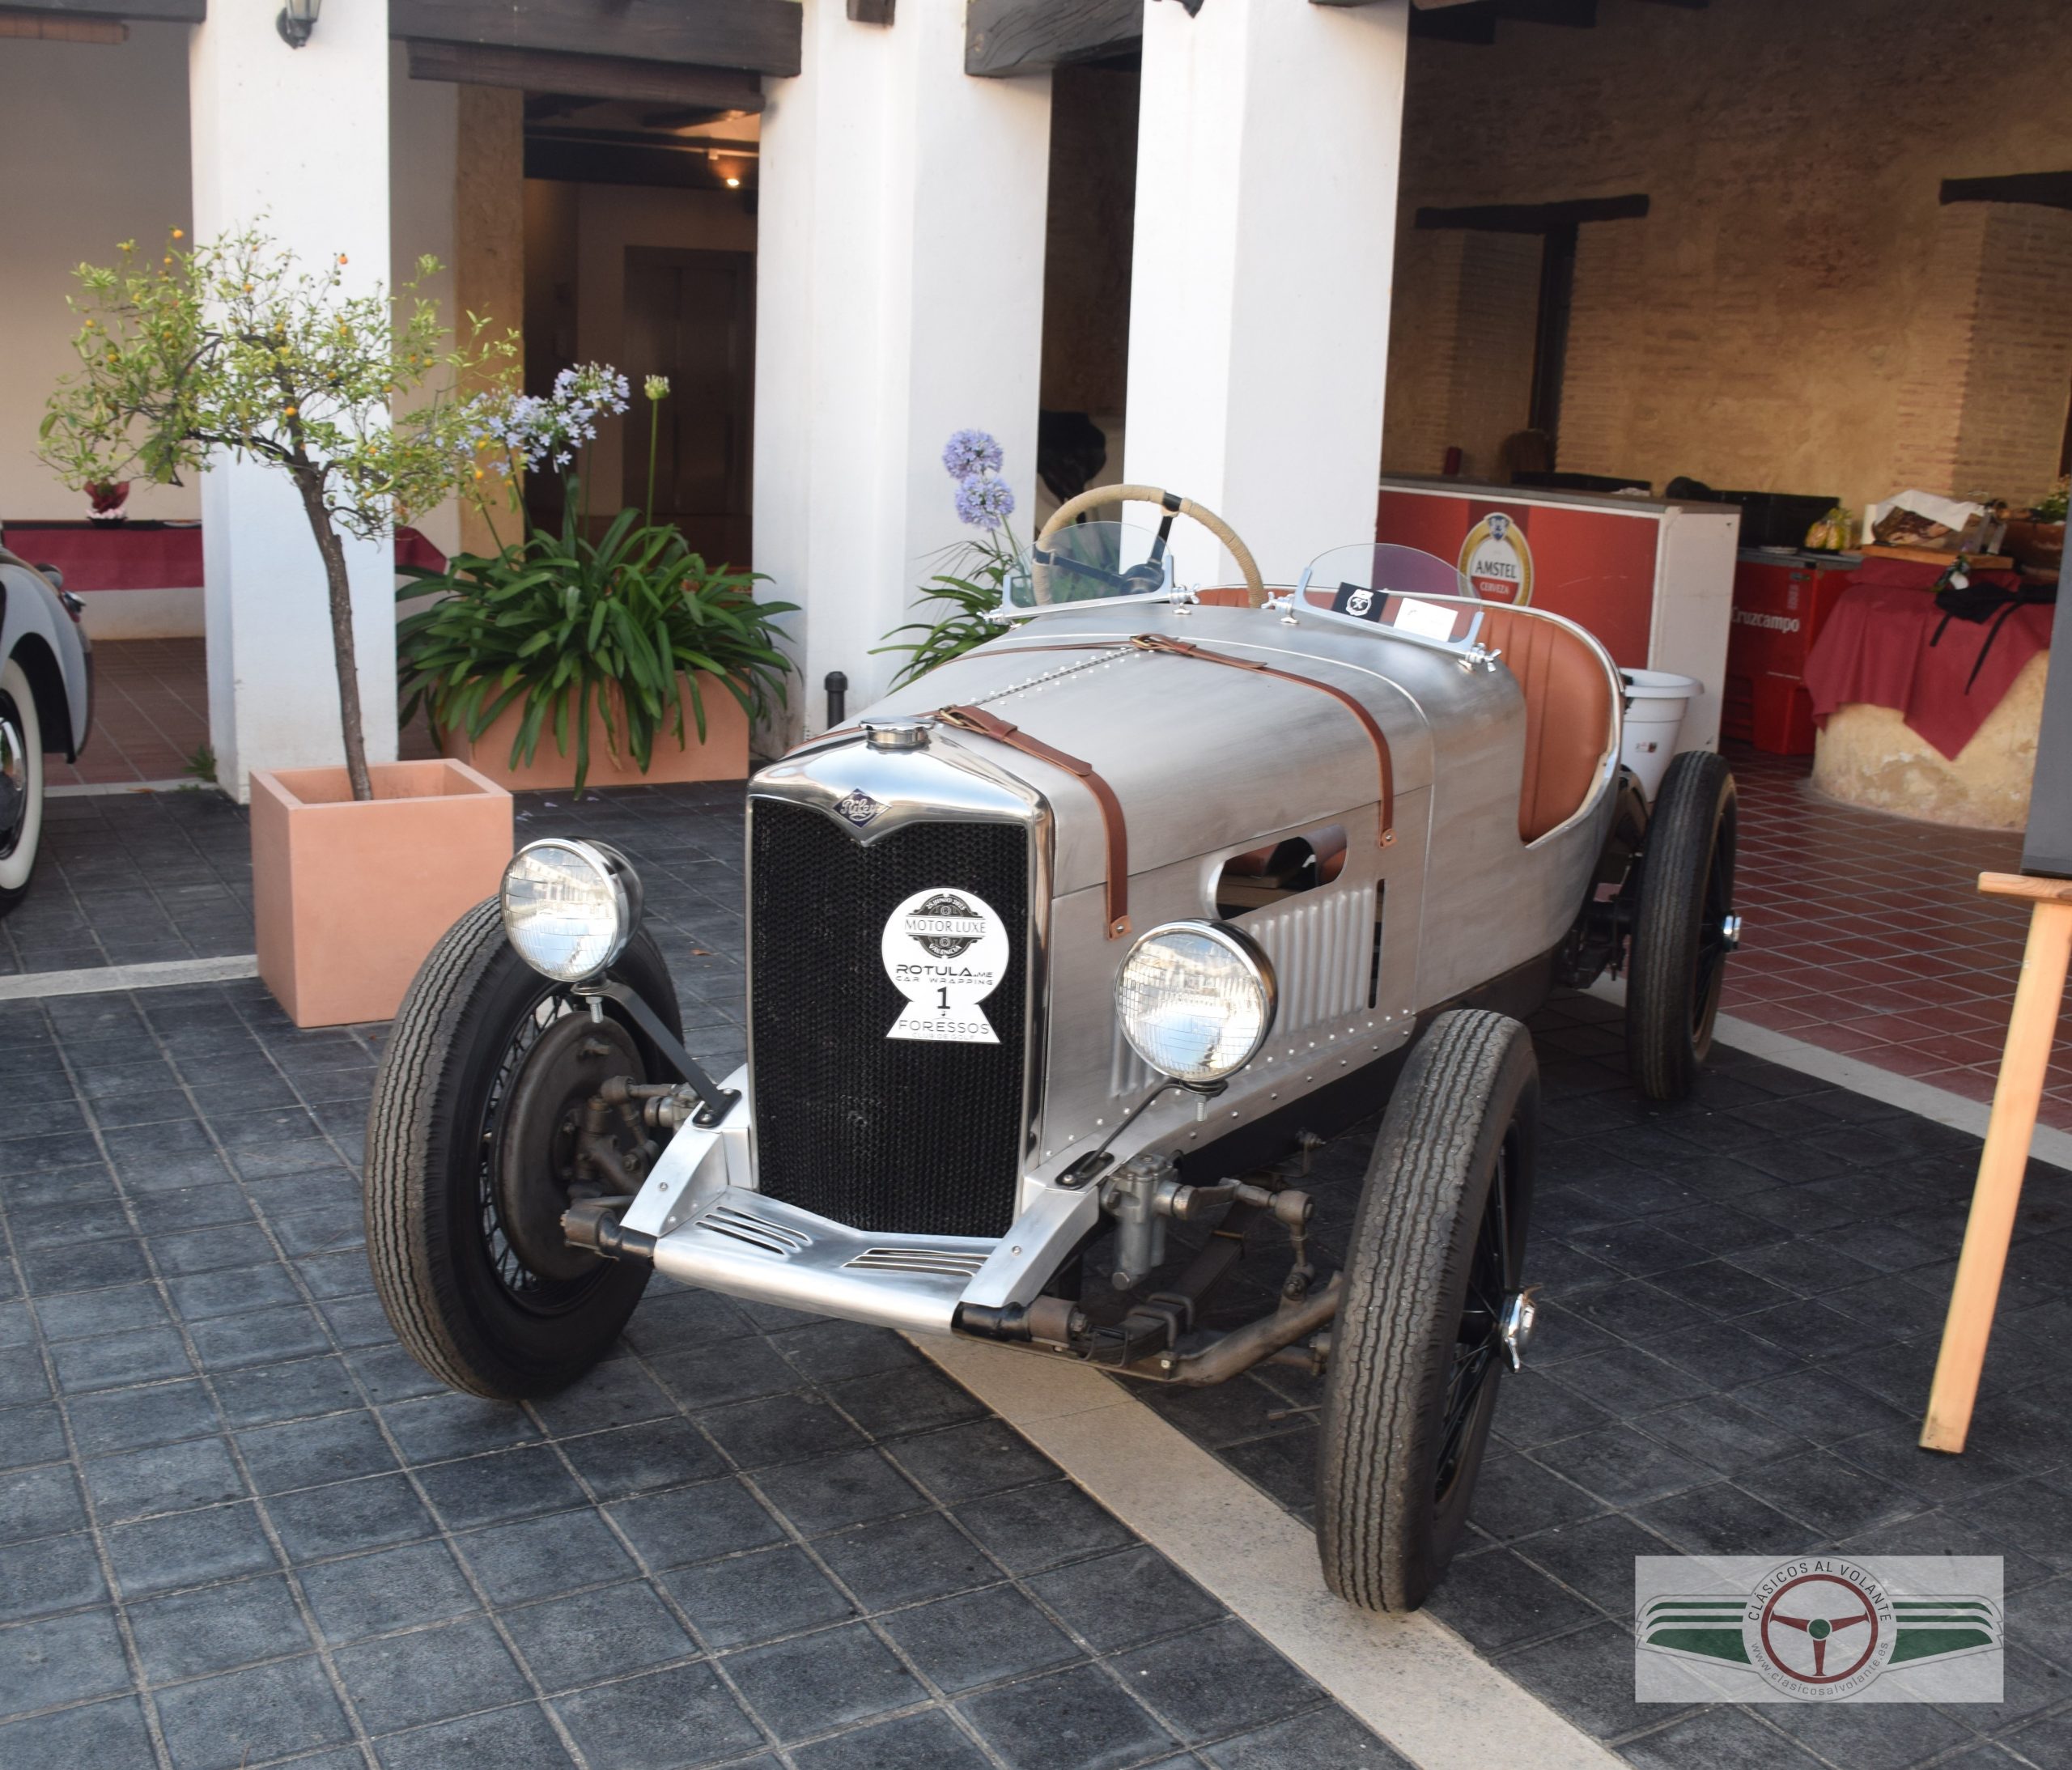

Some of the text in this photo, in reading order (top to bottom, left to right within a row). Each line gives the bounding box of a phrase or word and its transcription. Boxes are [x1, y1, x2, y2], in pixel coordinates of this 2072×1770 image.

[1475, 560, 1517, 579] AMSTEL
[1480, 581, 1510, 595] CERVEZA
[905, 919, 987, 933] MOTOR LUXE
[928, 943, 962, 955] VALENCIA
[929, 977, 993, 985] WRAPPING
[937, 987, 951, 1009] 1
[898, 1020, 989, 1034] FORESSOS
